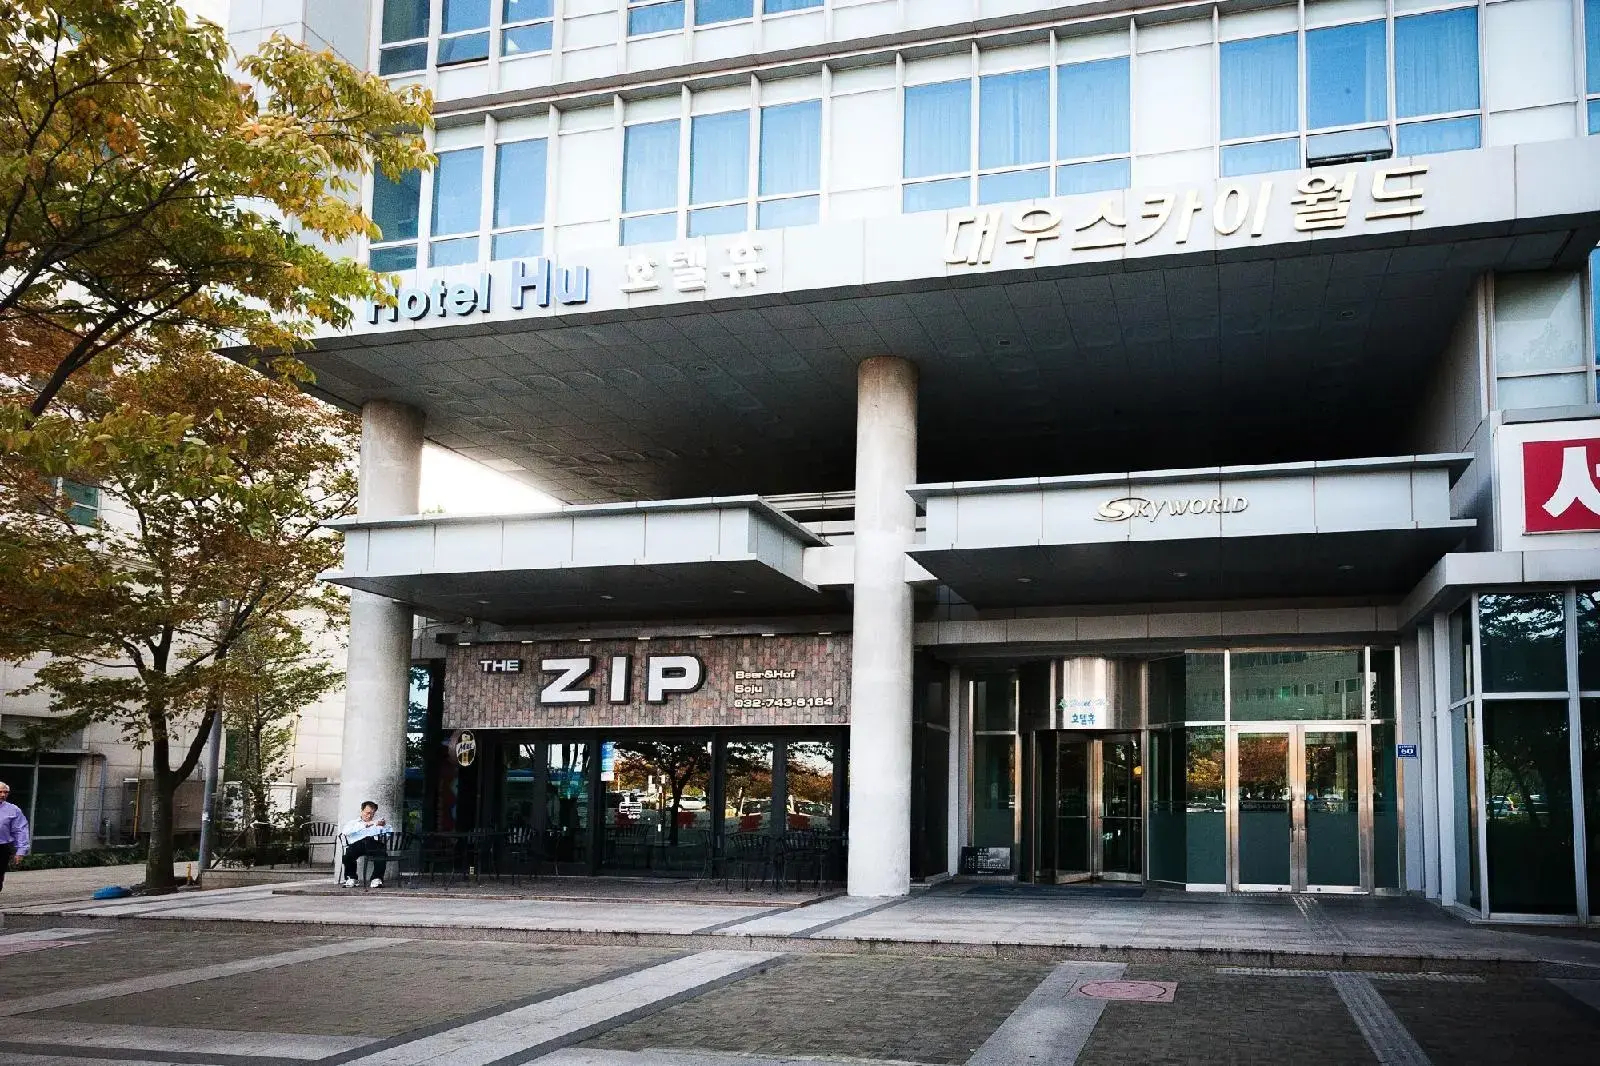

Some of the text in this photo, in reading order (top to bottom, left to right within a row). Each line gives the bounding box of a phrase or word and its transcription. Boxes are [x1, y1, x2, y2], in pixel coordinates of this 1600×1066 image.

[511, 256, 589, 310] Hu
[479, 654, 703, 704] THE ZIP
[734, 684, 763, 694] Soju
